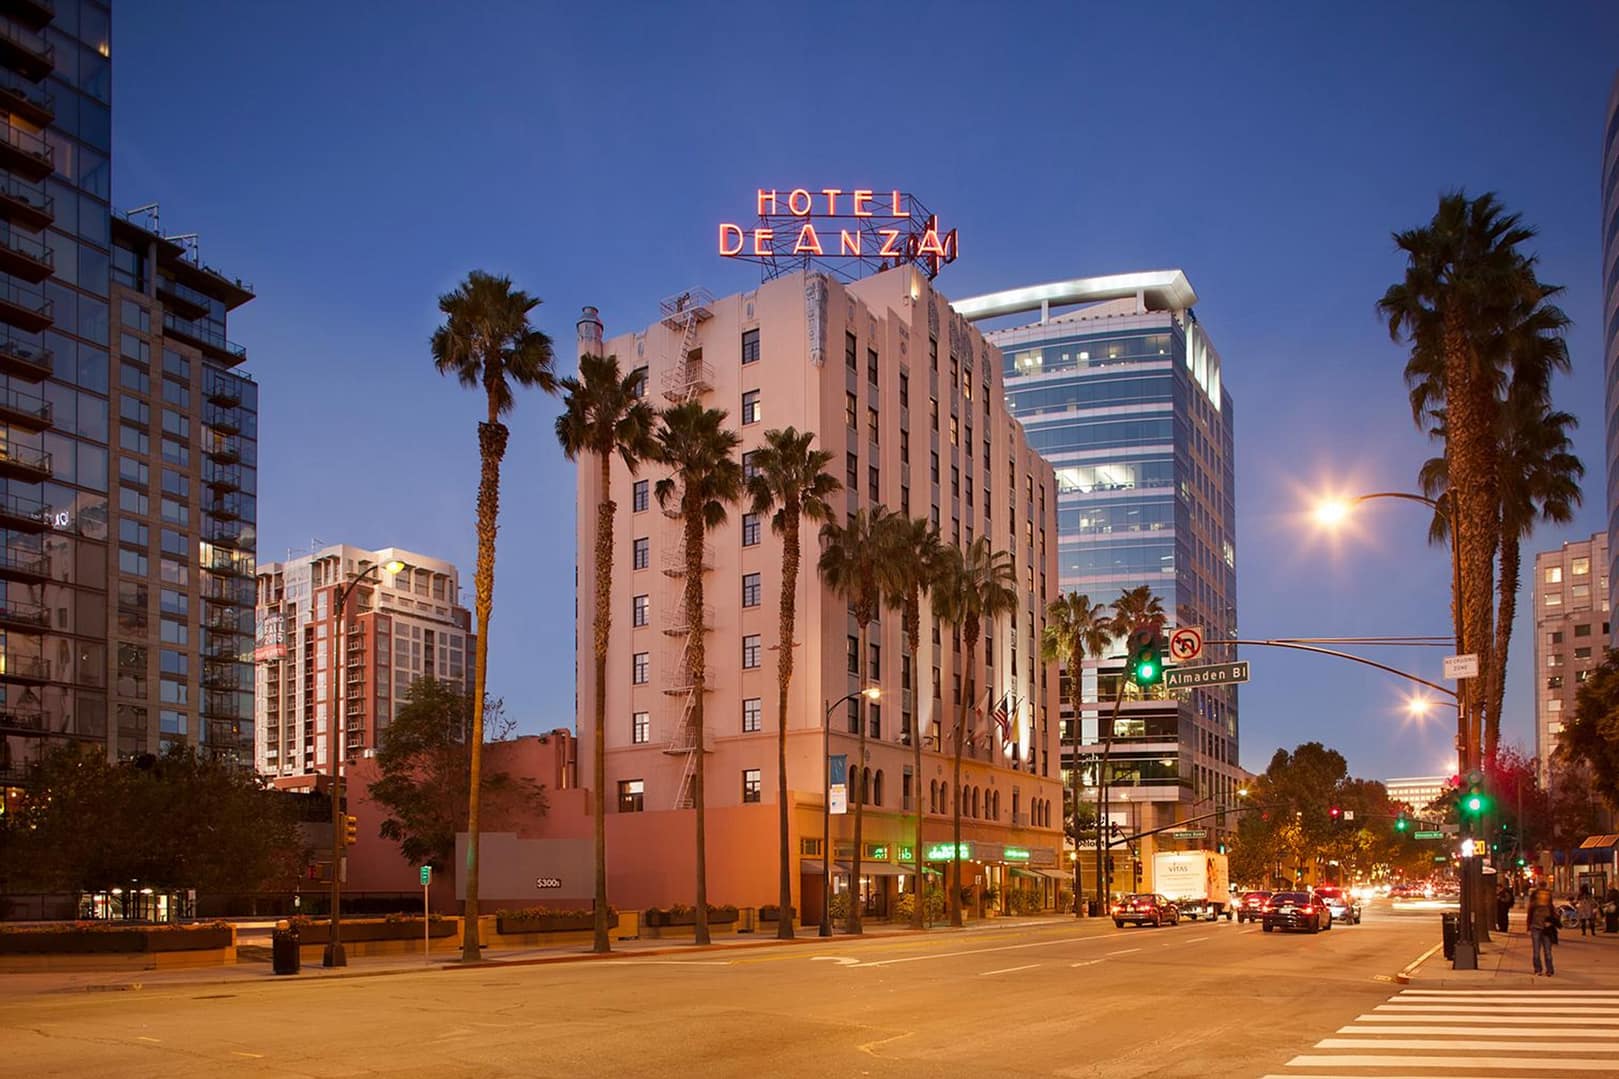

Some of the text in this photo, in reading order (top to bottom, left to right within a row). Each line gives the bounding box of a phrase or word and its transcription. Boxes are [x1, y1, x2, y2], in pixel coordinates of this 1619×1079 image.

[757, 188, 910, 217] HOTEL
[1168, 669, 1226, 685] Almaden
[1168, 865, 1189, 873] VITAS
